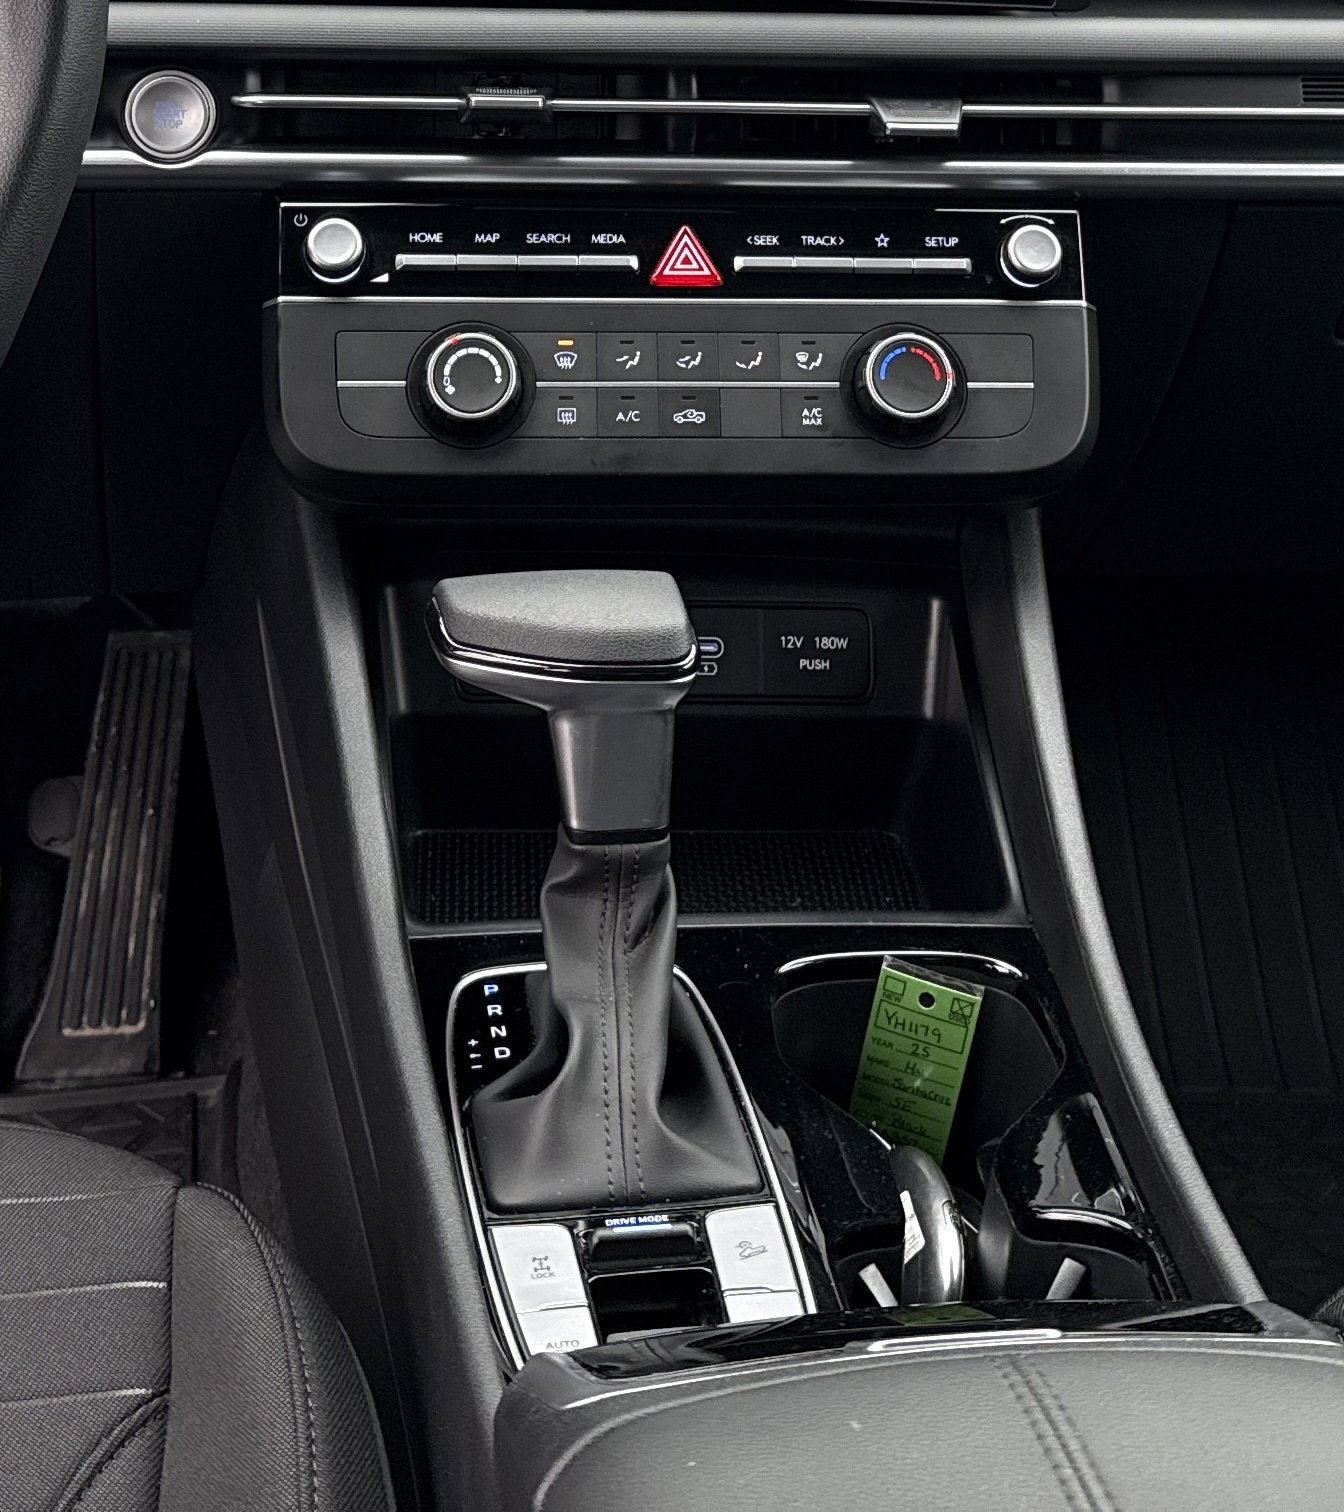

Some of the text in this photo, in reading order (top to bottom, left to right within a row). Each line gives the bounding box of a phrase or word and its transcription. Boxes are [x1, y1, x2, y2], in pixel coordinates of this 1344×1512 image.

[409, 232, 444, 244] HOME
[474, 233, 500, 244] MAP
[526, 233, 571, 244] SEARCH
[591, 234, 626, 244] MEDIA
[925, 236, 959, 248] SETUP
[616, 410, 640, 423] A/C
[802, 408, 823, 418] A/C
[802, 418, 823, 426] MAX
[780, 636, 848, 650] 12V 180W
[800, 659, 830, 670] PUSH
[484, 984, 498, 996] P
[487, 1004, 503, 1016] R
[490, 1025, 506, 1038] N
[884, 1008, 942, 1044] YH1179
[494, 1047, 510, 1058] D
[910, 1043, 930, 1058] 25
[605, 1215, 670, 1226] DRIVE MODE
[530, 1272, 556, 1280] LOCK
[546, 1340, 580, 1350] AUTO
